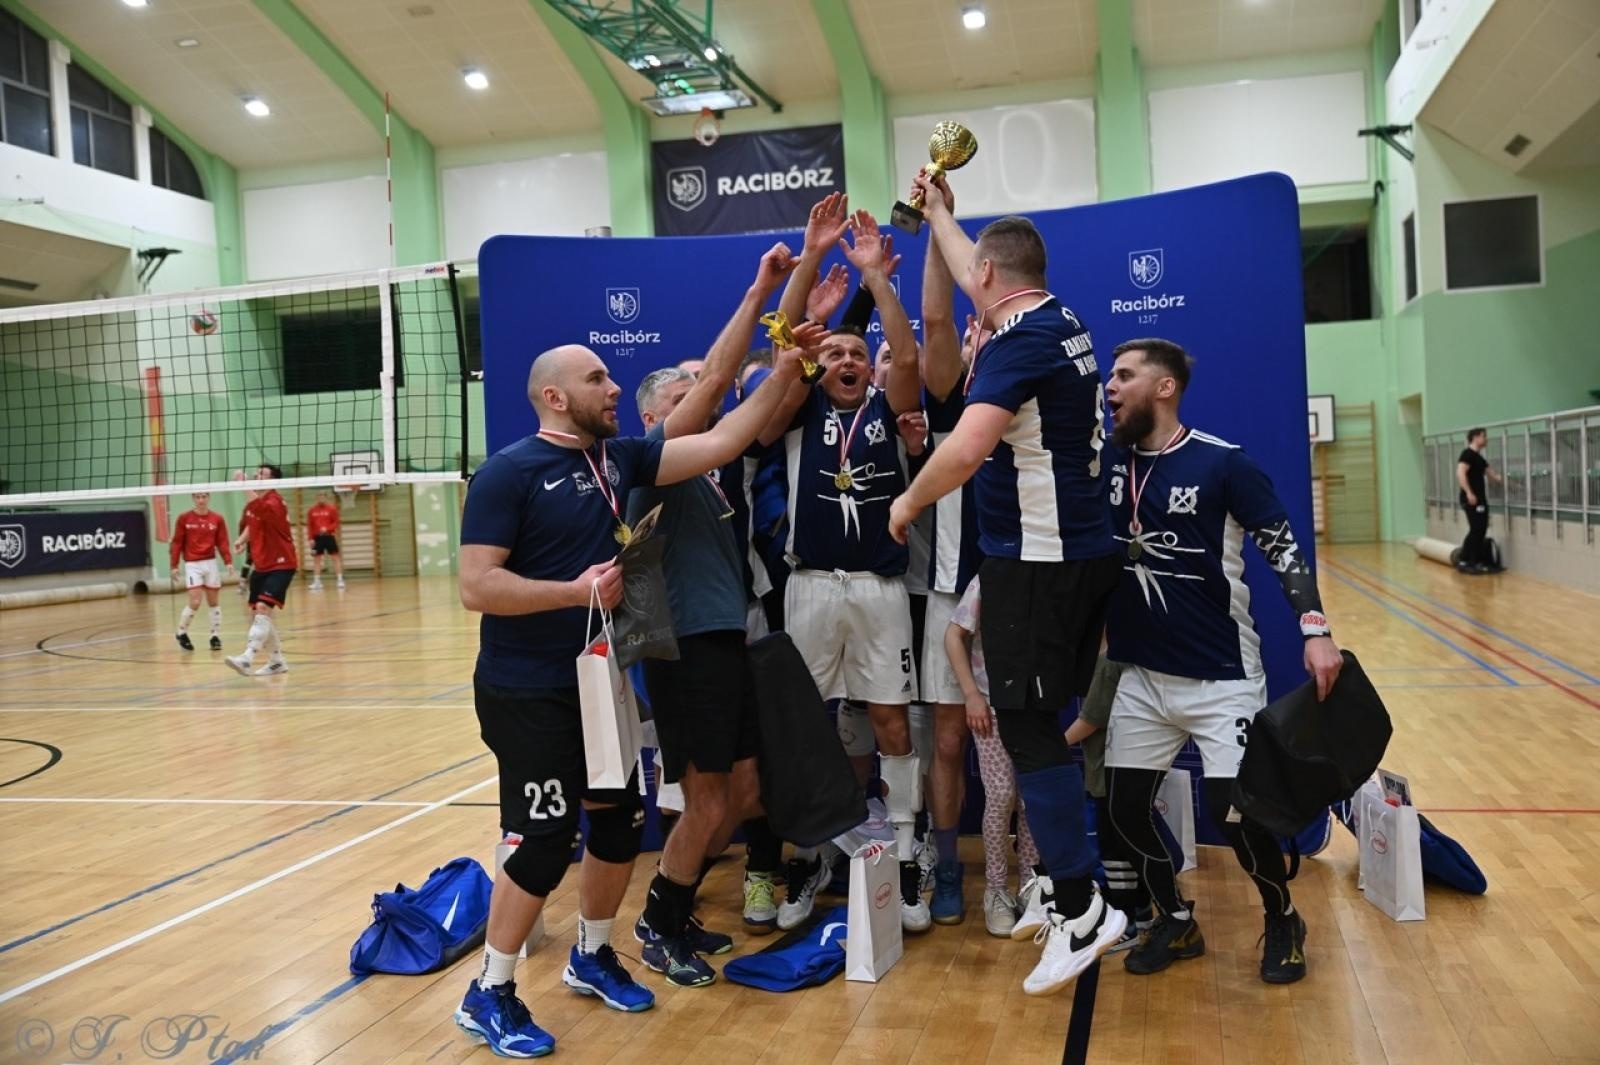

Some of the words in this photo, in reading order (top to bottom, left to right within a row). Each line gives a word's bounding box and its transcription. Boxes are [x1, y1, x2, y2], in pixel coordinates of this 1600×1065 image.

[717, 165, 834, 196] RACIBÓRZ
[1111, 293, 1186, 313] Racibórz
[1138, 314, 1159, 325] 1217
[589, 330, 661, 345] Racibórz
[615, 347, 636, 358] 1217
[823, 419, 838, 446] 5
[1110, 476, 1124, 506] 3
[42, 527, 126, 553] RACIBÓRZ
[900, 647, 911, 674] 5
[1235, 717, 1249, 748] 3
[524, 778, 567, 820] 23
